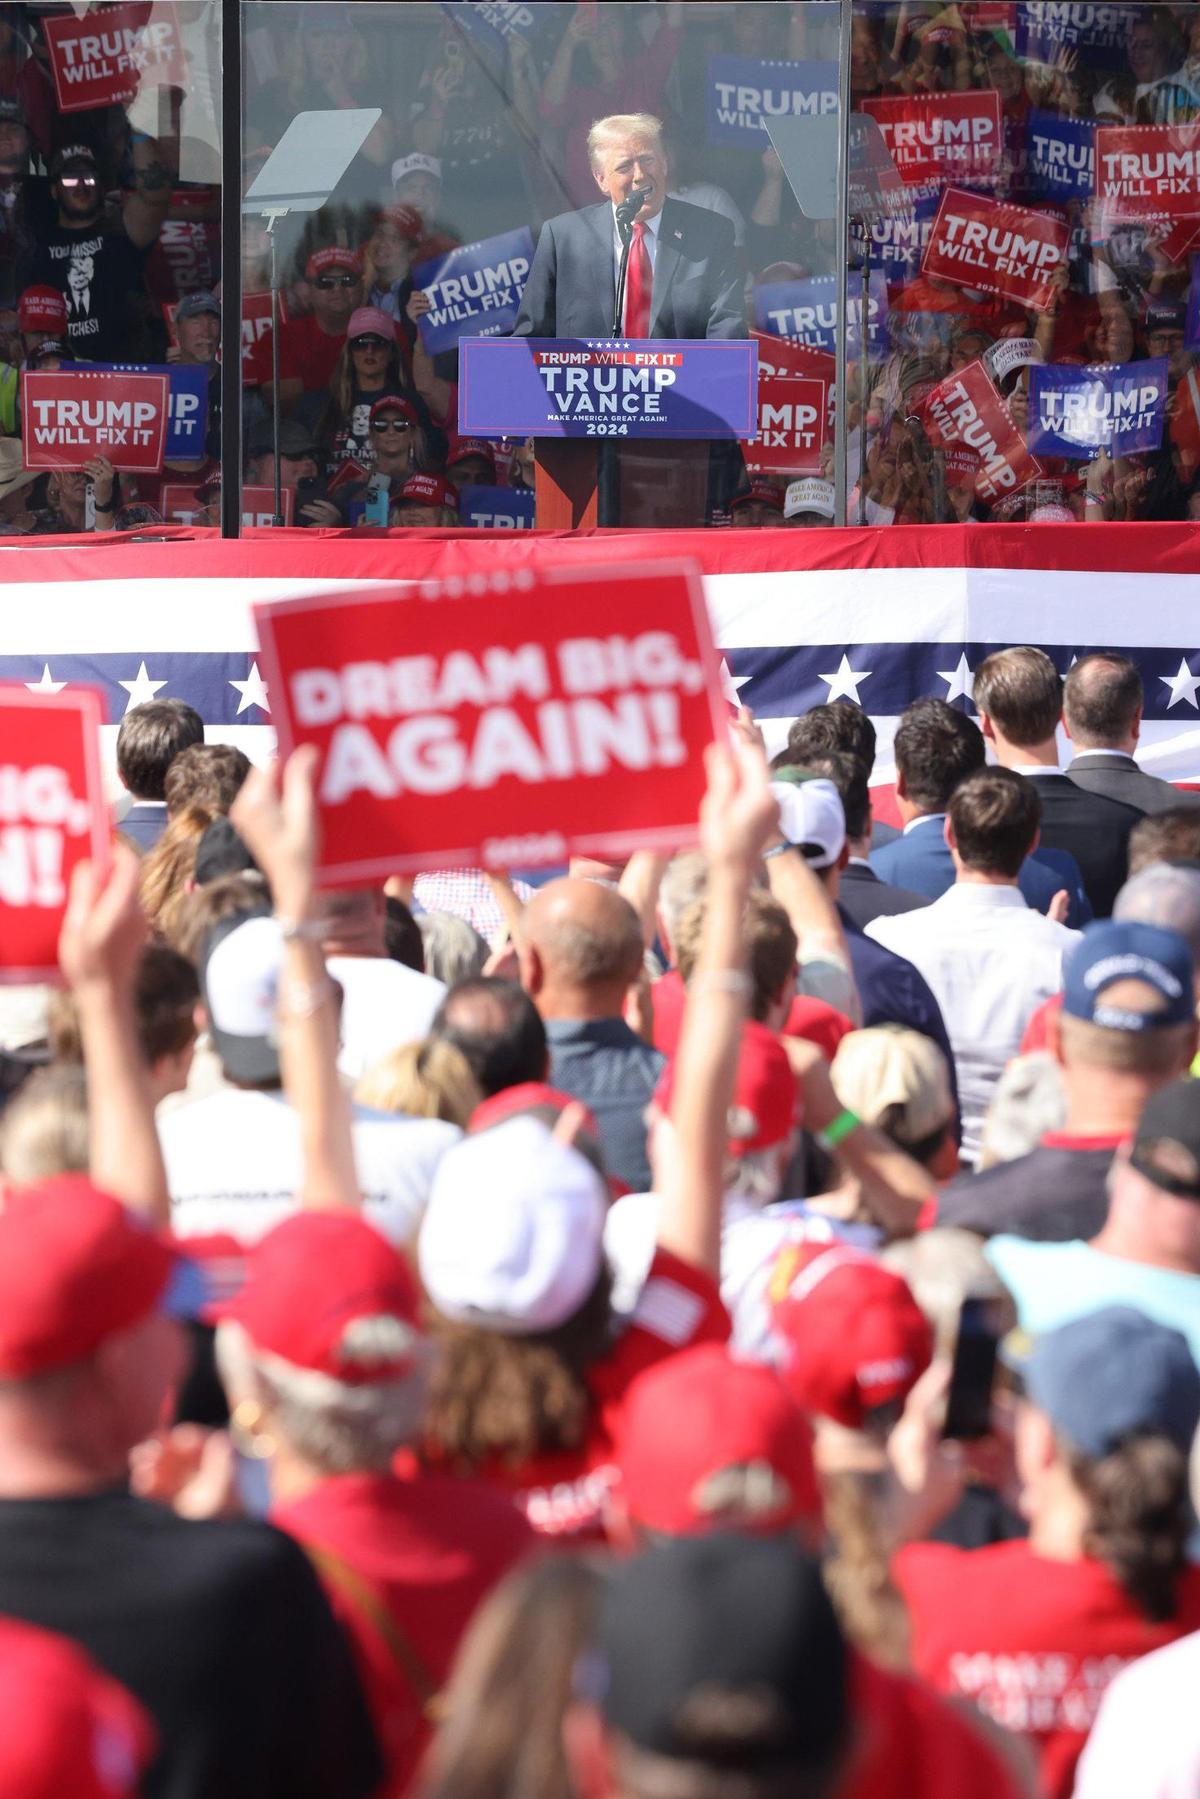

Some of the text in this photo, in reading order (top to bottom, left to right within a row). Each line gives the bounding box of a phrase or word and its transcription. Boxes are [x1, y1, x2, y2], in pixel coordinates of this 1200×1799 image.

[57, 22, 173, 65] TRUMP
[62, 44, 175, 84] WILL FIX IT
[715, 82, 840, 116] TRUMP
[877, 117, 994, 146] TRUMP
[933, 144, 967, 161] FIX
[974, 142, 993, 159] IT
[1032, 135, 1094, 170] TRU
[1033, 159, 1072, 183] WILL
[1077, 171, 1094, 188] FI
[1102, 151, 1200, 180] TRUM
[1104, 178, 1191, 198] WILL FIX
[48, 242, 71, 259] YOU
[944, 214, 1060, 267] TRUMP
[882, 245, 914, 263] FIX
[938, 240, 1052, 285] WILL FIX IT
[422, 257, 529, 311] TRUMP
[976, 282, 1000, 293] 2024
[426, 301, 479, 328] WILL
[481, 287, 514, 312] FIX
[67, 318, 100, 337] TCHES!
[479, 325, 501, 337] 2024
[540, 352, 676, 365] TRUMP WILL FIX IT
[540, 367, 677, 393] TRUMP
[32, 400, 157, 427] TRUMP
[555, 393, 660, 413] VANCE
[1039, 386, 1159, 419] TRUMP
[174, 419, 197, 435] IT
[586, 423, 629, 435] 2024
[944, 380, 1016, 488] TRUMP
[1102, 415, 1132, 434] FIX
[1137, 411, 1156, 428] IT
[34, 428, 154, 446] WILL FIX IT
[747, 430, 816, 448] FIX IT
[1088, 450, 1112, 458] 204
[975, 478, 998, 499] IT
[291, 630, 704, 727] DREAM BIG,
[320, 690, 687, 805] AGAIN!
[0, 763, 92, 838] IG,
